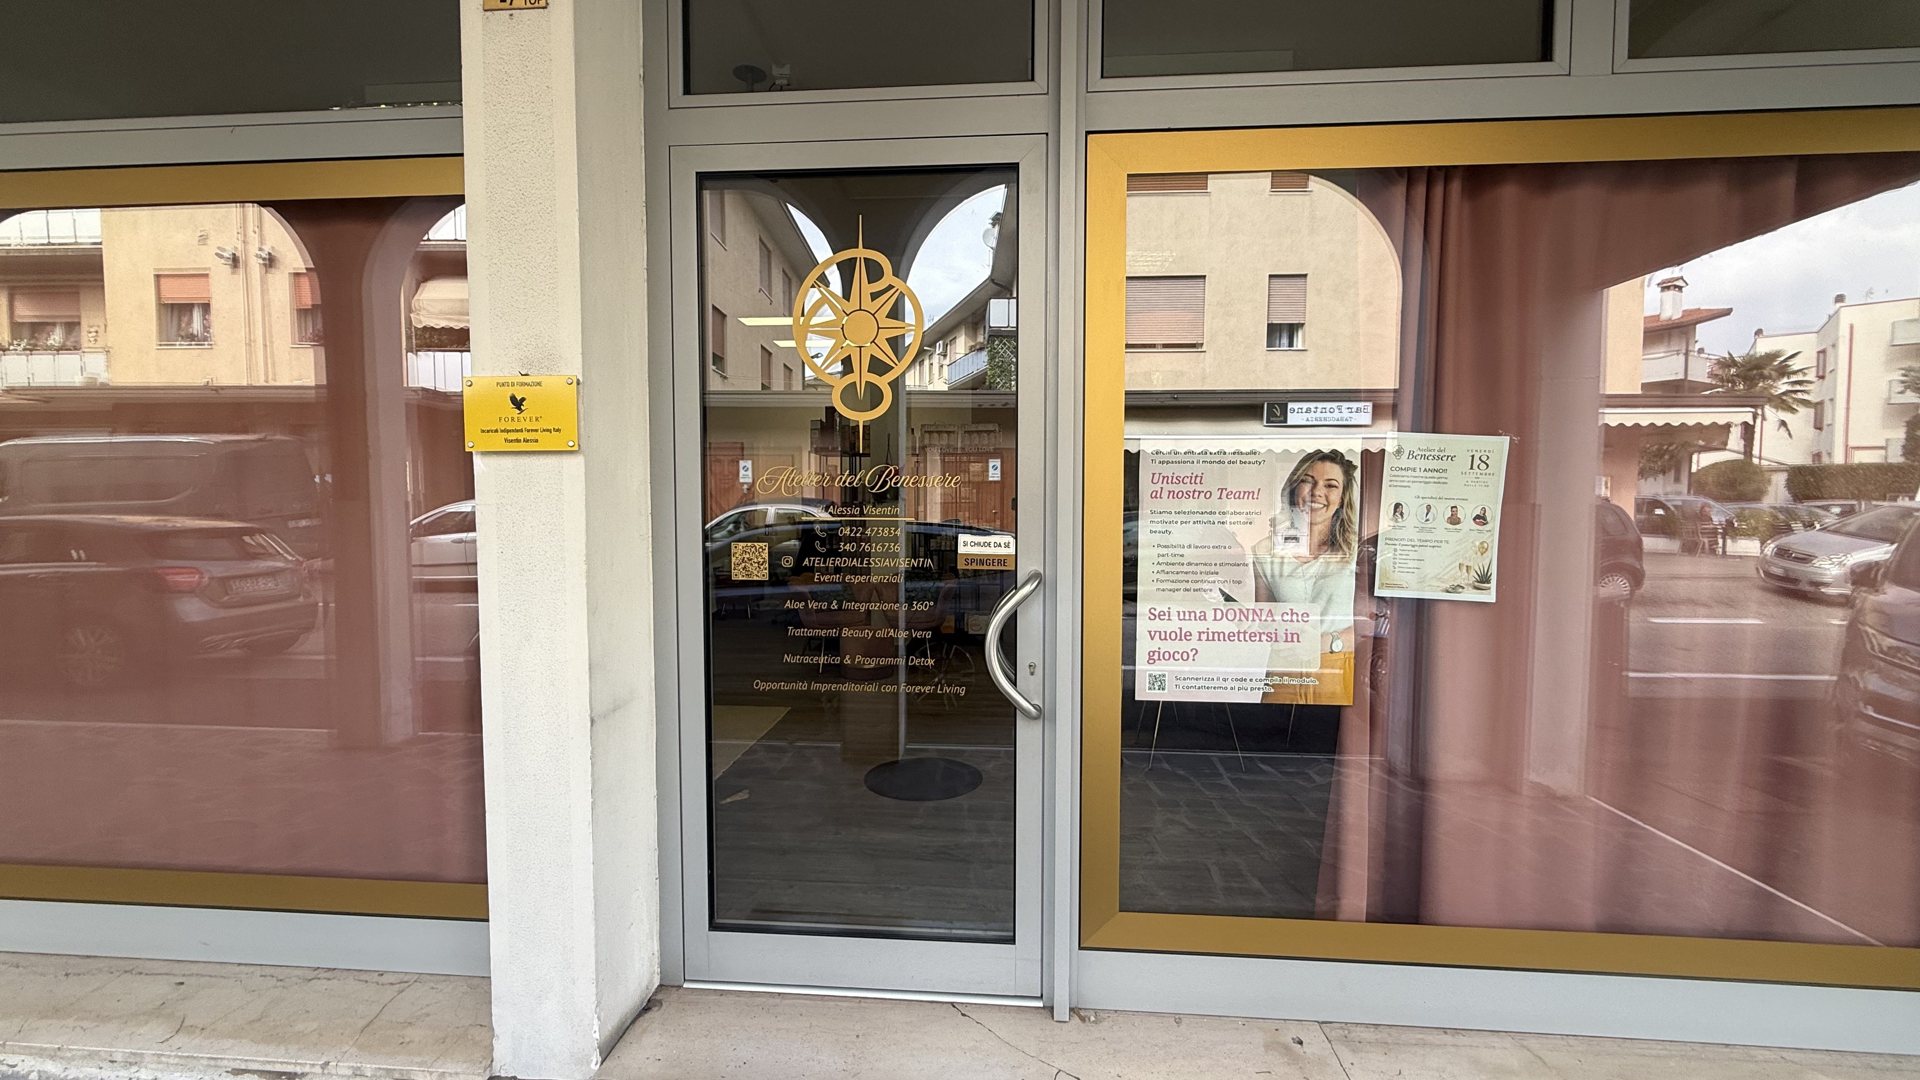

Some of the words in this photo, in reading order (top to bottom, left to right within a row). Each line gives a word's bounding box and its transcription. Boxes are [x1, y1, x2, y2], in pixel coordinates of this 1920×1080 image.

[1407, 450, 1456, 461] Benessere
[1468, 454, 1490, 471] 18
[756, 464, 832, 496] Atelier
[835, 469, 865, 488] del
[865, 464, 961, 493] Benessere
[1150, 472, 1204, 485] Unisciti
[1150, 487, 1163, 500] al
[1167, 489, 1212, 500] nostro
[1217, 488, 1261, 500] Team!
[828, 505, 860, 515] Alessia
[863, 505, 900, 515] Visentin
[838, 527, 862, 537] 0422
[865, 527, 901, 537] 473834
[838, 543, 856, 552] 340
[859, 543, 901, 552] 7616736
[964, 558, 1008, 567] SPINGERE
[814, 573, 842, 582] Eventi
[845, 573, 904, 585] esperienziali
[784, 600, 804, 609] Aloe
[808, 601, 827, 610] Vera
[831, 600, 838, 610] &
[842, 601, 900, 612] Integrazione
[911, 601, 934, 611] 360°
[1148, 607, 1171, 621] Sei
[1176, 610, 1207, 621] una
[1212, 608, 1276, 622] DONNA
[1281, 608, 1310, 623] che
[787, 627, 839, 637] Trattamenti
[842, 628, 873, 639] Beauty
[912, 629, 932, 638] Vera
[1147, 628, 1192, 642] vuole
[1196, 628, 1279, 643] rimettersi
[1283, 629, 1301, 643] in
[783, 654, 840, 665] Nutraceutica
[844, 655, 852, 665] &
[855, 655, 906, 667] Programmi
[908, 656, 935, 666] Detox
[1147, 647, 1198, 664] gioco?
[753, 680, 808, 691] Opportunità
[810, 681, 879, 692] Imprenditoriali
[900, 683, 935, 693] Forever
[937, 683, 966, 696] Living
